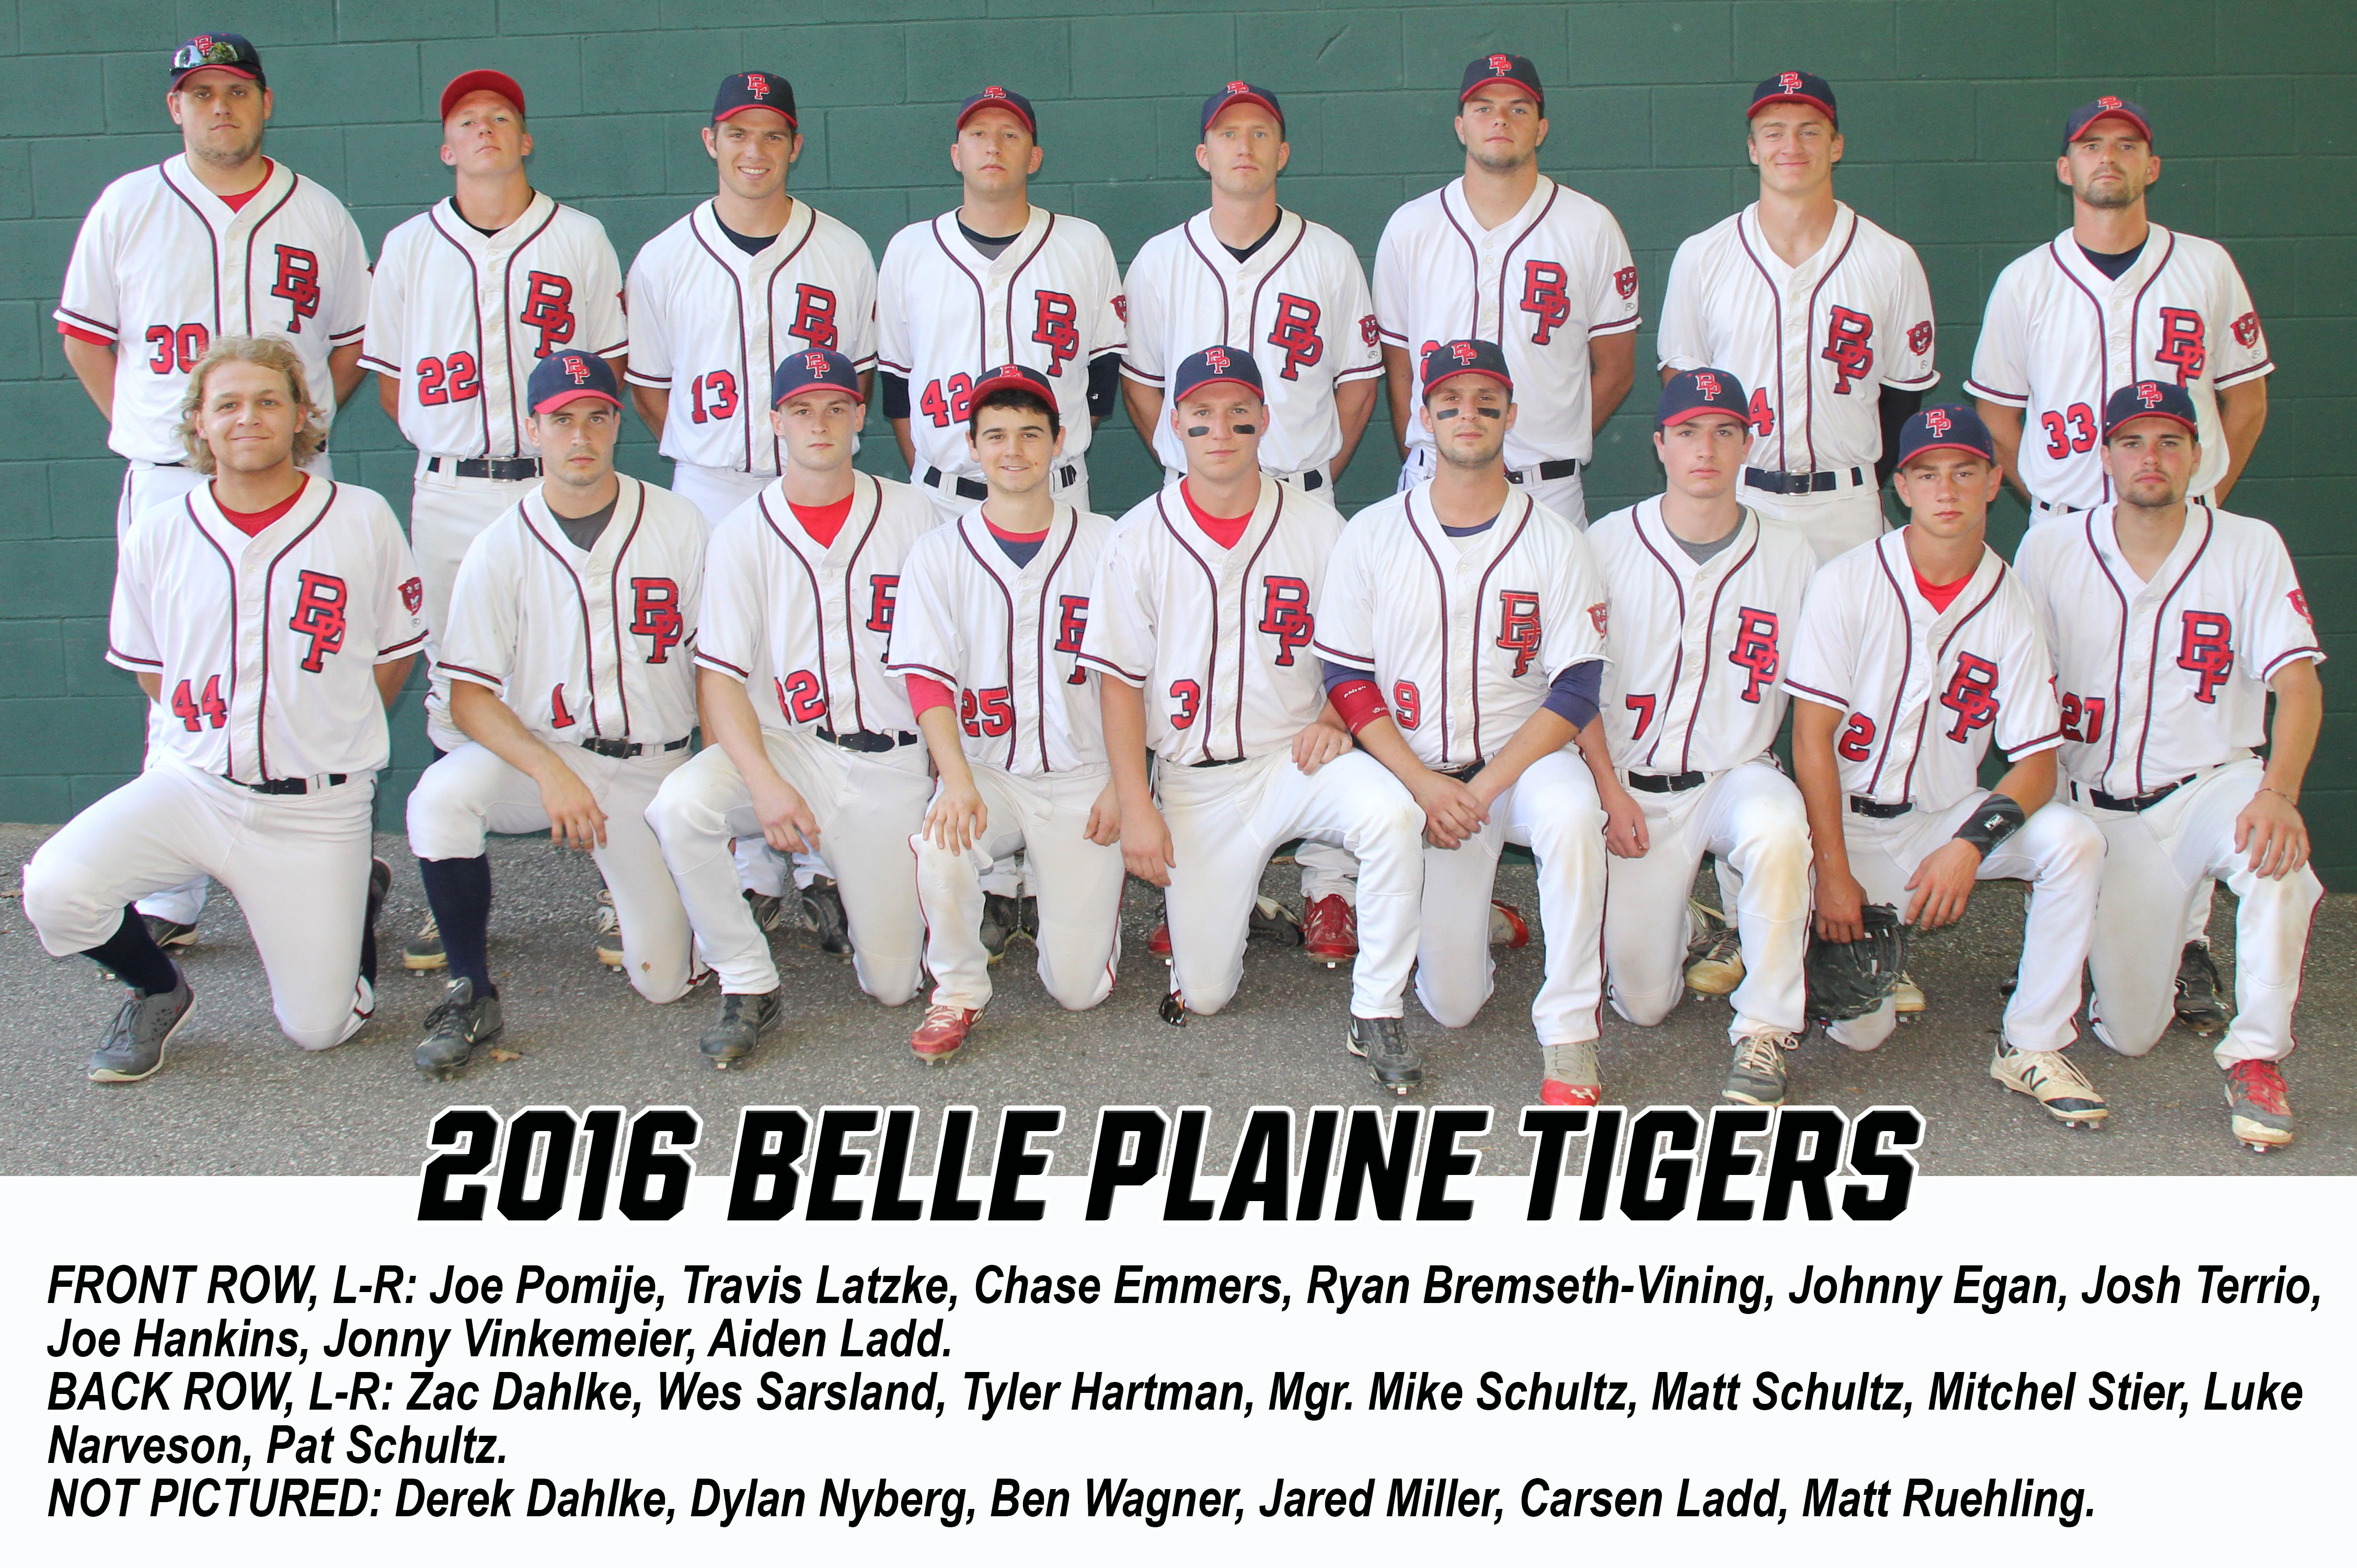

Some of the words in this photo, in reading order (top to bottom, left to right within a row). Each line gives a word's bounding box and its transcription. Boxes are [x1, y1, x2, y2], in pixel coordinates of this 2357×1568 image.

[747, 74, 770, 100] BP
[1489, 54, 1511, 76] BP
[1778, 71, 1802, 94] BP
[271, 244, 320, 334] BP
[520, 270, 576, 359] BP
[1520, 260, 1571, 345] BP
[146, 324, 210, 374] 30
[1032, 290, 1079, 377] BP
[1268, 293, 1324, 381] BP
[1452, 341, 1477, 365] BP
[1822, 304, 1873, 396] BP
[2155, 307, 2206, 388] BP
[417, 351, 479, 406] 22
[565, 356, 590, 385] BP
[806, 353, 829, 378] BP
[1205, 348, 1231, 374] BP
[1696, 373, 1721, 401] BP
[691, 370, 738, 424] 13
[920, 372, 972, 428] 42
[2137, 381, 2163, 409] BP
[1926, 409, 1951, 437] BP
[2041, 402, 2098, 459] 33
[290, 569, 347, 673] BP
[630, 577, 683, 664] BP
[1259, 575, 1314, 666] BP
[1496, 589, 1542, 678] BP
[1729, 607, 1779, 704] BP
[2177, 610, 2234, 704] BP
[171, 675, 227, 732] 44
[551, 683, 576, 728] 1
[961, 686, 1012, 737] 25
[1170, 679, 1200, 730] 3
[1393, 680, 1421, 730] 9
[1626, 694, 1657, 741] 7
[1940, 651, 1999, 744] BP
[2061, 692, 2106, 744] 21
[1838, 711, 1876, 762] 2
